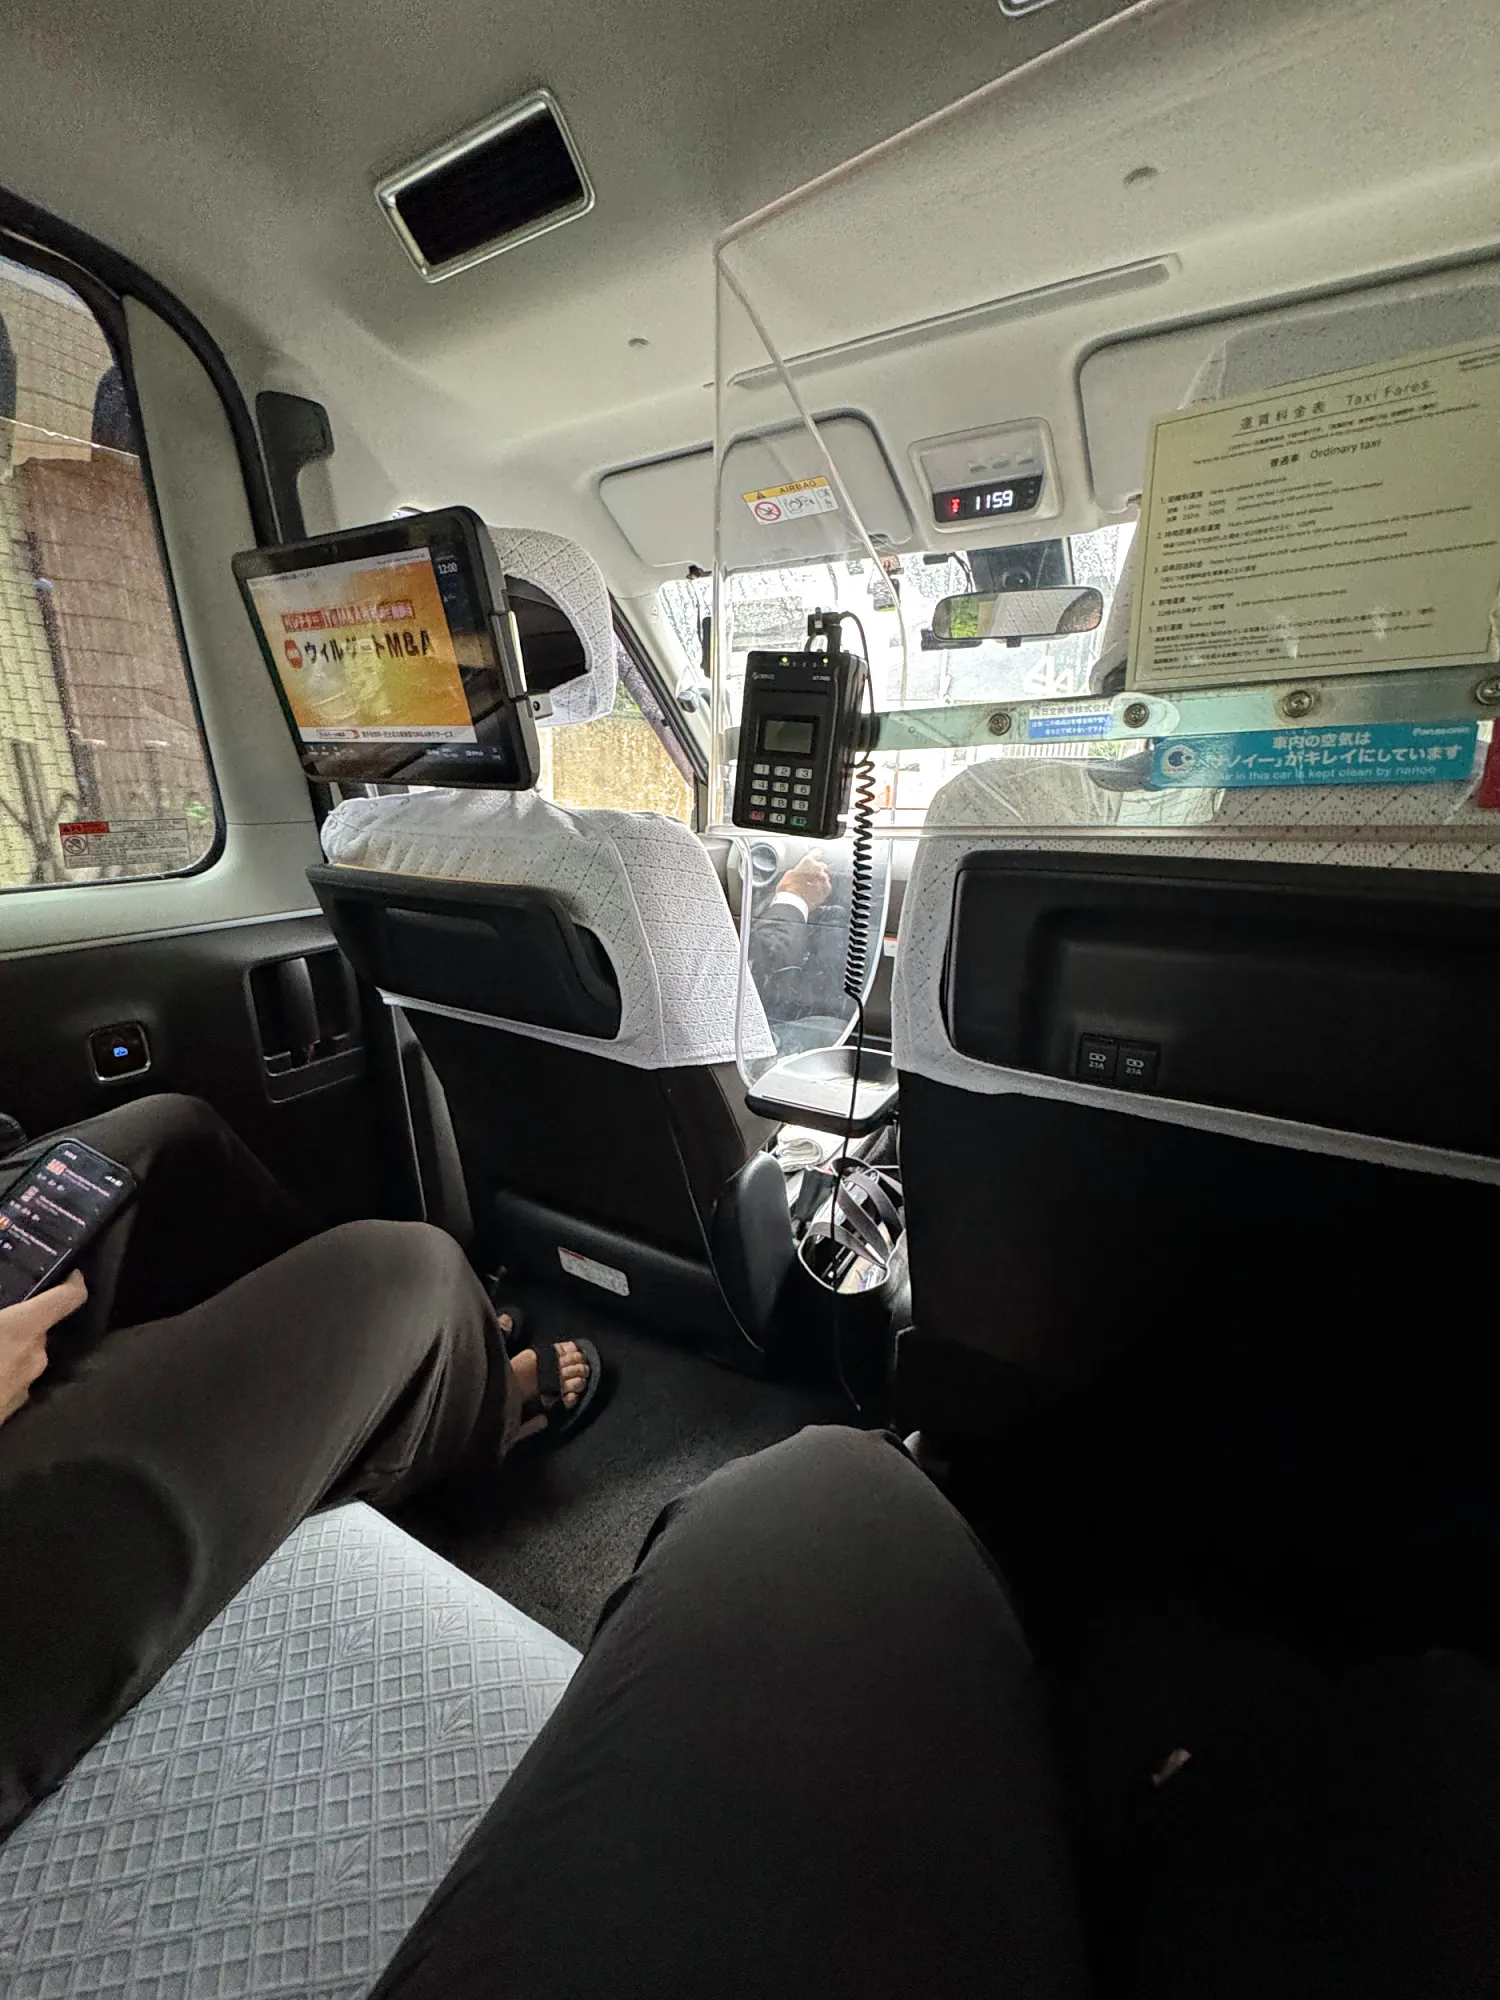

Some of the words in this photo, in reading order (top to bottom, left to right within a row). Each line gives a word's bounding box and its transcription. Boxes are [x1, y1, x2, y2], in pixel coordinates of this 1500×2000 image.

[1346, 392, 1379, 406] Taxi
[1384, 380, 1430, 399] Fares
[1240, 401, 1327, 430] 運賃料金表
[1310, 443, 1358, 460] Ordinary
[1359, 438, 1382, 451] taxi
[778, 480, 818, 494] AIRBAG
[437, 562, 458, 575] 12:00
[1412, 726, 1471, 737] Panasonic
[1272, 731, 1372, 750] 車内の空気は
[1250, 770, 1271, 780] this
[1272, 769, 1292, 779] car
[1308, 768, 1335, 779] kept
[1338, 767, 1373, 777] clean
[1376, 766, 1393, 777] by
